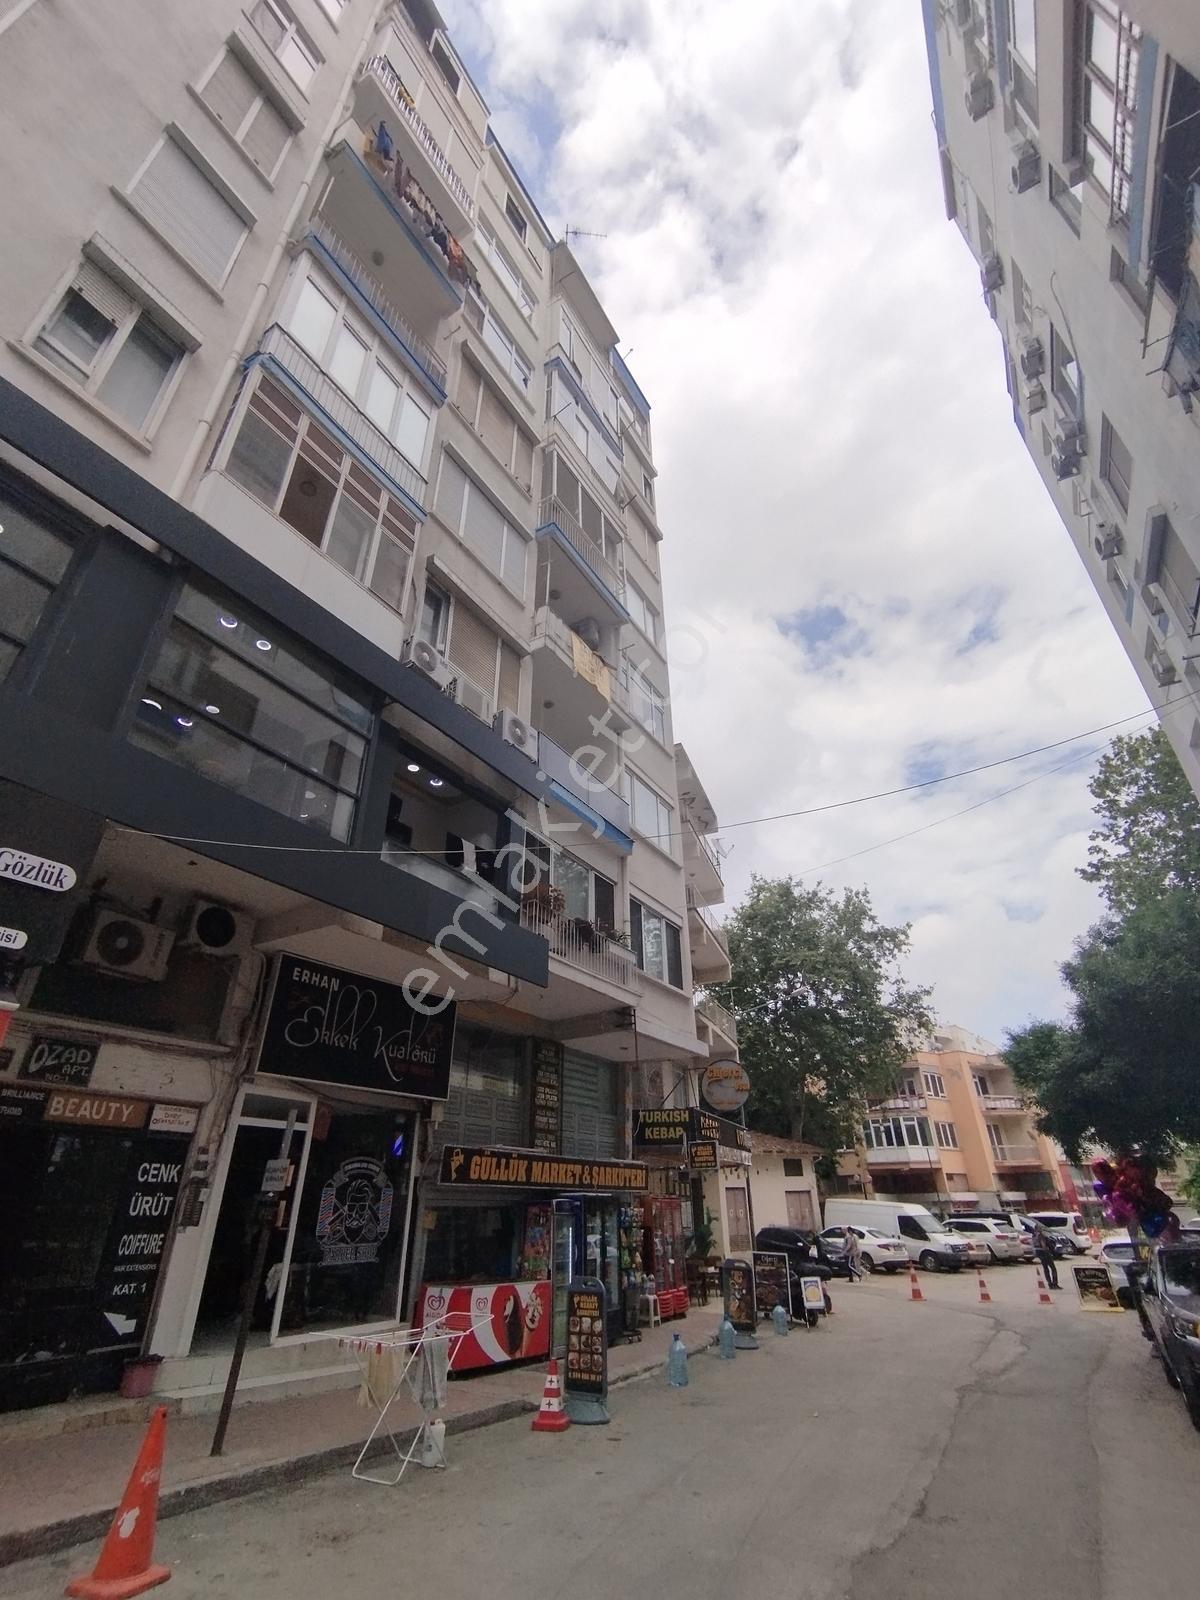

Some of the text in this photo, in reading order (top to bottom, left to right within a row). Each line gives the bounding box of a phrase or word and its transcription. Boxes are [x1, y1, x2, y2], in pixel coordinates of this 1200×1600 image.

[0, 849, 69, 889] Gözlük
[0, 929, 18, 945] isi
[292, 967, 340, 992] ERHAN
[50, 1096, 135, 1122] BEAUTY
[639, 1110, 689, 1123] TURKISH
[645, 1127, 685, 1140] KEBAP
[137, 1162, 182, 1183] CENK
[469, 1151, 528, 1183] GÜLLÜK
[530, 1160, 582, 1185] MARKET
[129, 1192, 173, 1217] ÜRÜT
[118, 1233, 165, 1256] COIFFURE
[112, 1282, 147, 1296] KAT. 1
